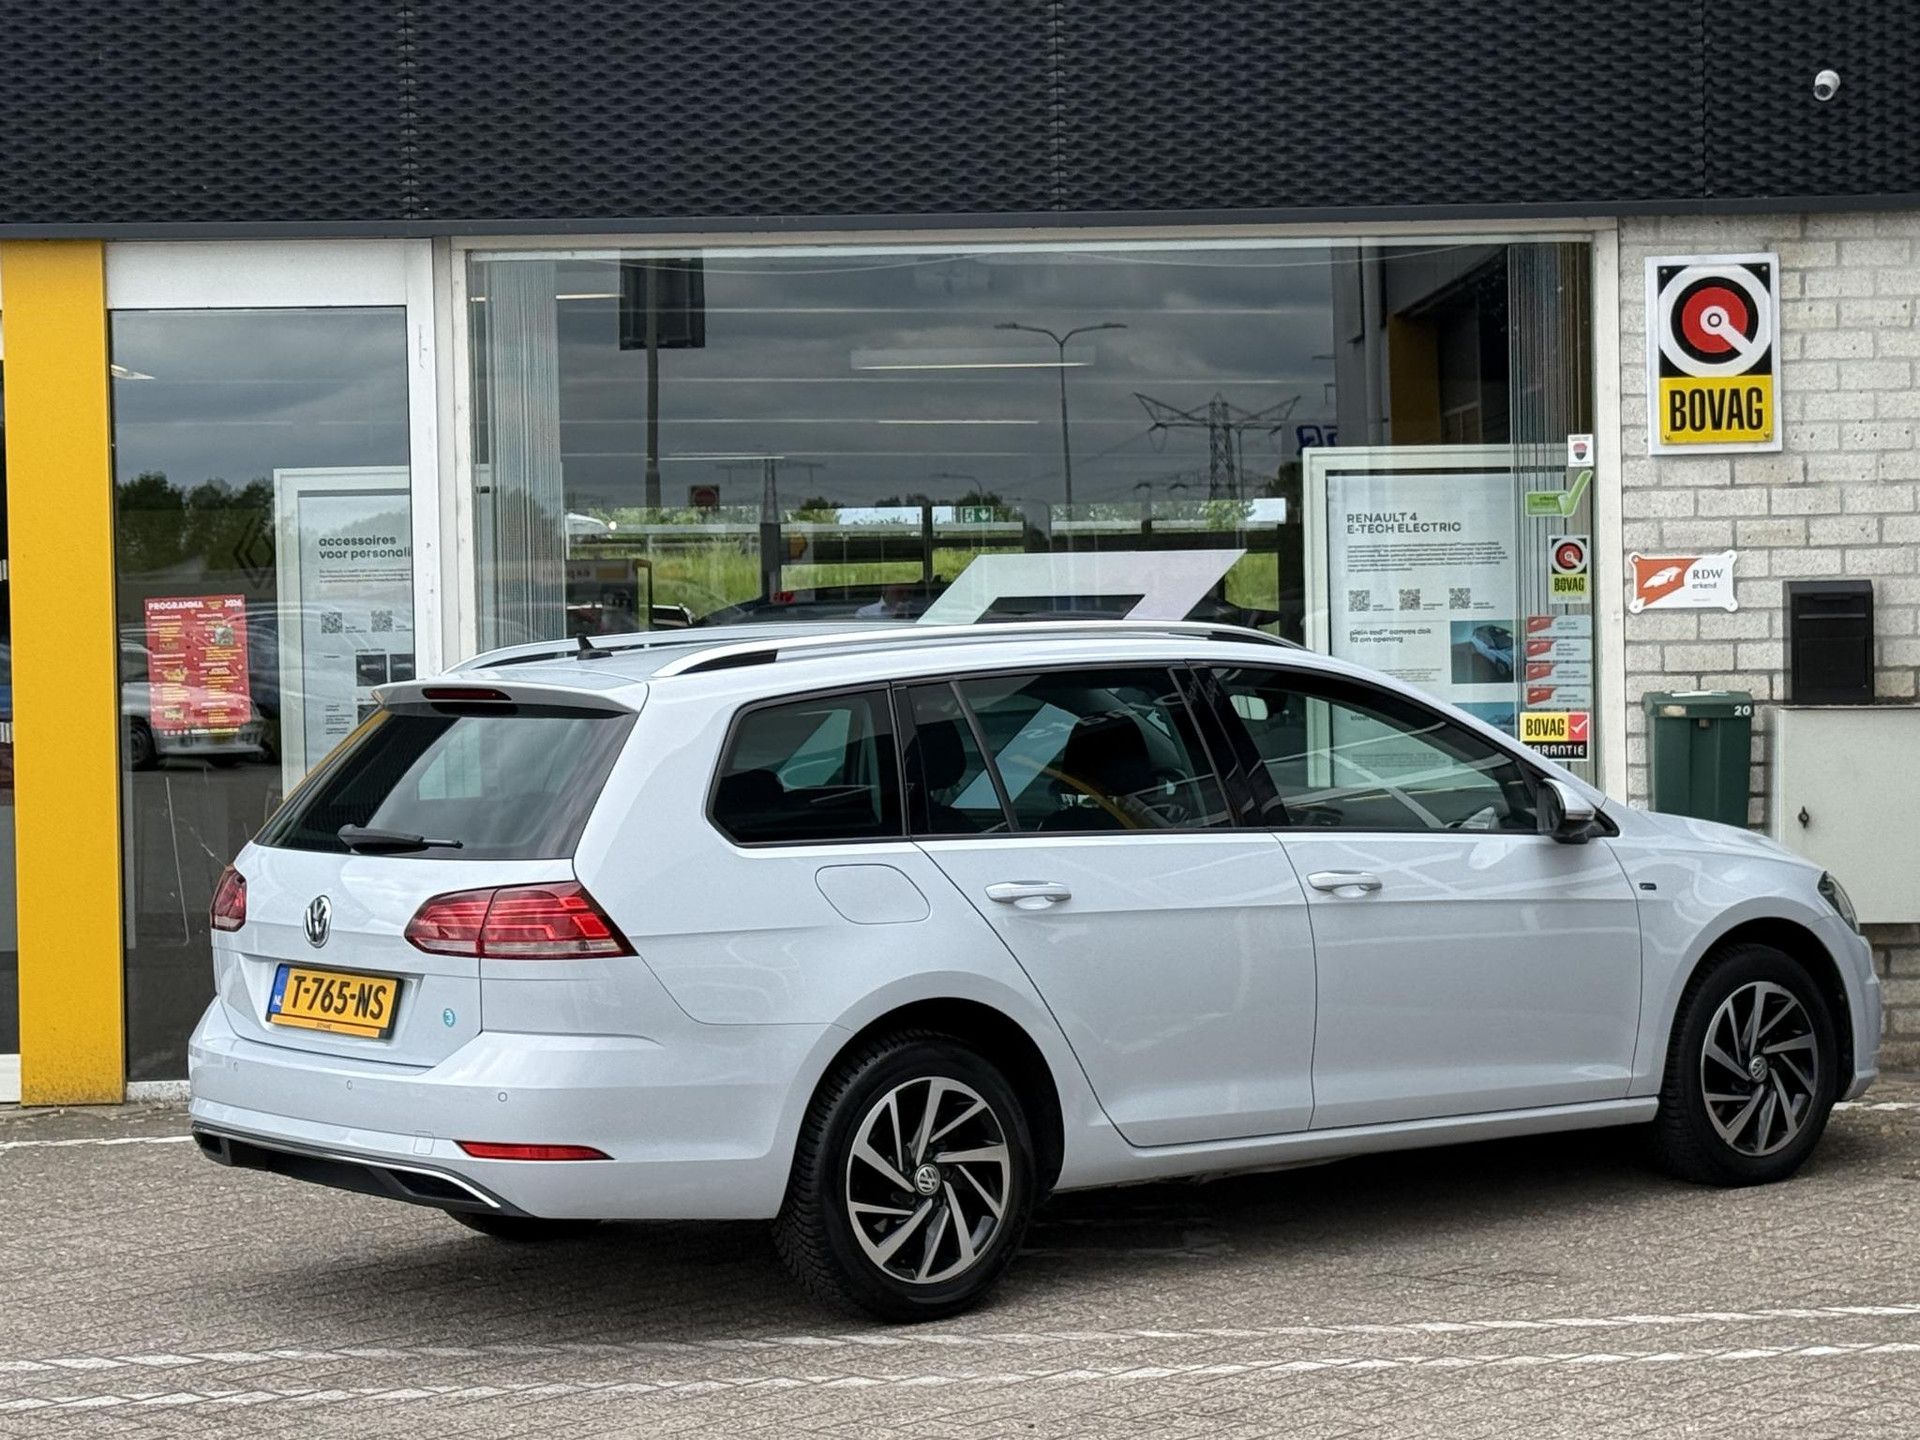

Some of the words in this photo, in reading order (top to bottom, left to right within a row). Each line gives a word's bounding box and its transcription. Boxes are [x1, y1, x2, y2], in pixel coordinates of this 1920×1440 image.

[1669, 387, 1763, 432] BOVAG
[1346, 512, 1407, 524] RENAULT
[1409, 512, 1418, 521] 4
[1346, 523, 1395, 534] E-TECH
[1397, 522, 1462, 534] ELECTRIC
[318, 535, 397, 546] accessoires
[319, 550, 348, 559] voor
[1692, 569, 1724, 579] RDW
[1554, 577, 1585, 592] BOVAG
[148, 601, 204, 610] PROGRAMMA
[1734, 705, 1751, 716] 20
[1526, 718, 1565, 737] BOVAG
[1529, 744, 1585, 756] ARANTIE
[293, 975, 388, 1020] T-765-NS
